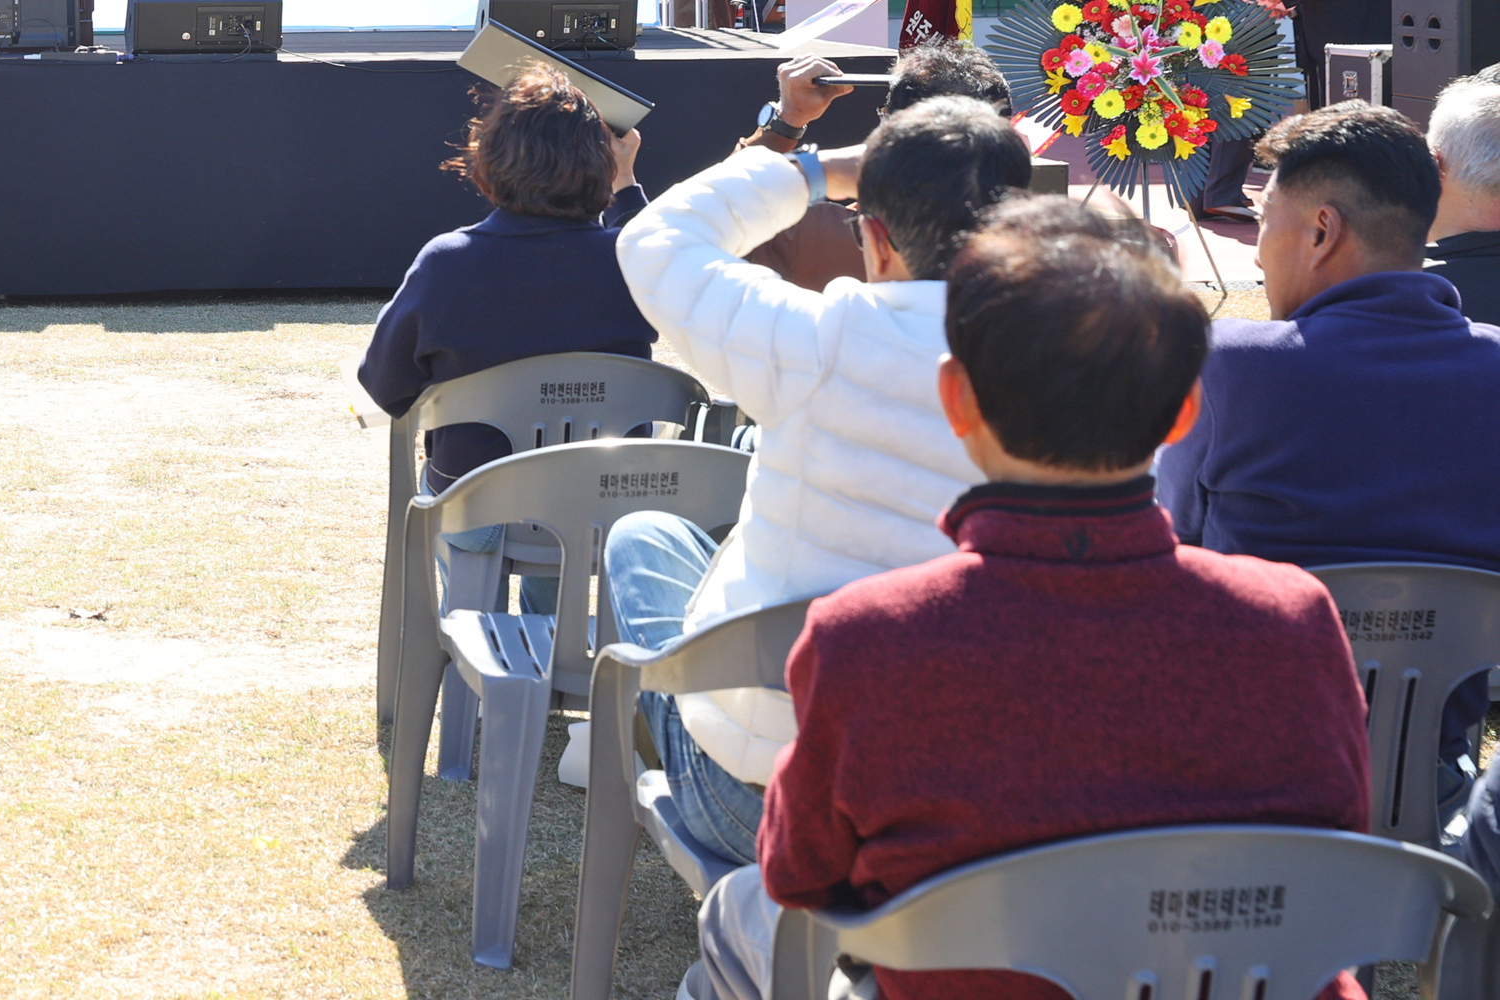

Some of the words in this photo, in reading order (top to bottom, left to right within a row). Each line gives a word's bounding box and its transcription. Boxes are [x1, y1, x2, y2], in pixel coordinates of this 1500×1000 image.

[540, 382, 606, 397] 테마엔터테인먼트
[599, 472, 679, 490] 테마엔터테인먼트
[599, 489, 678, 499] 010-3388-1542
